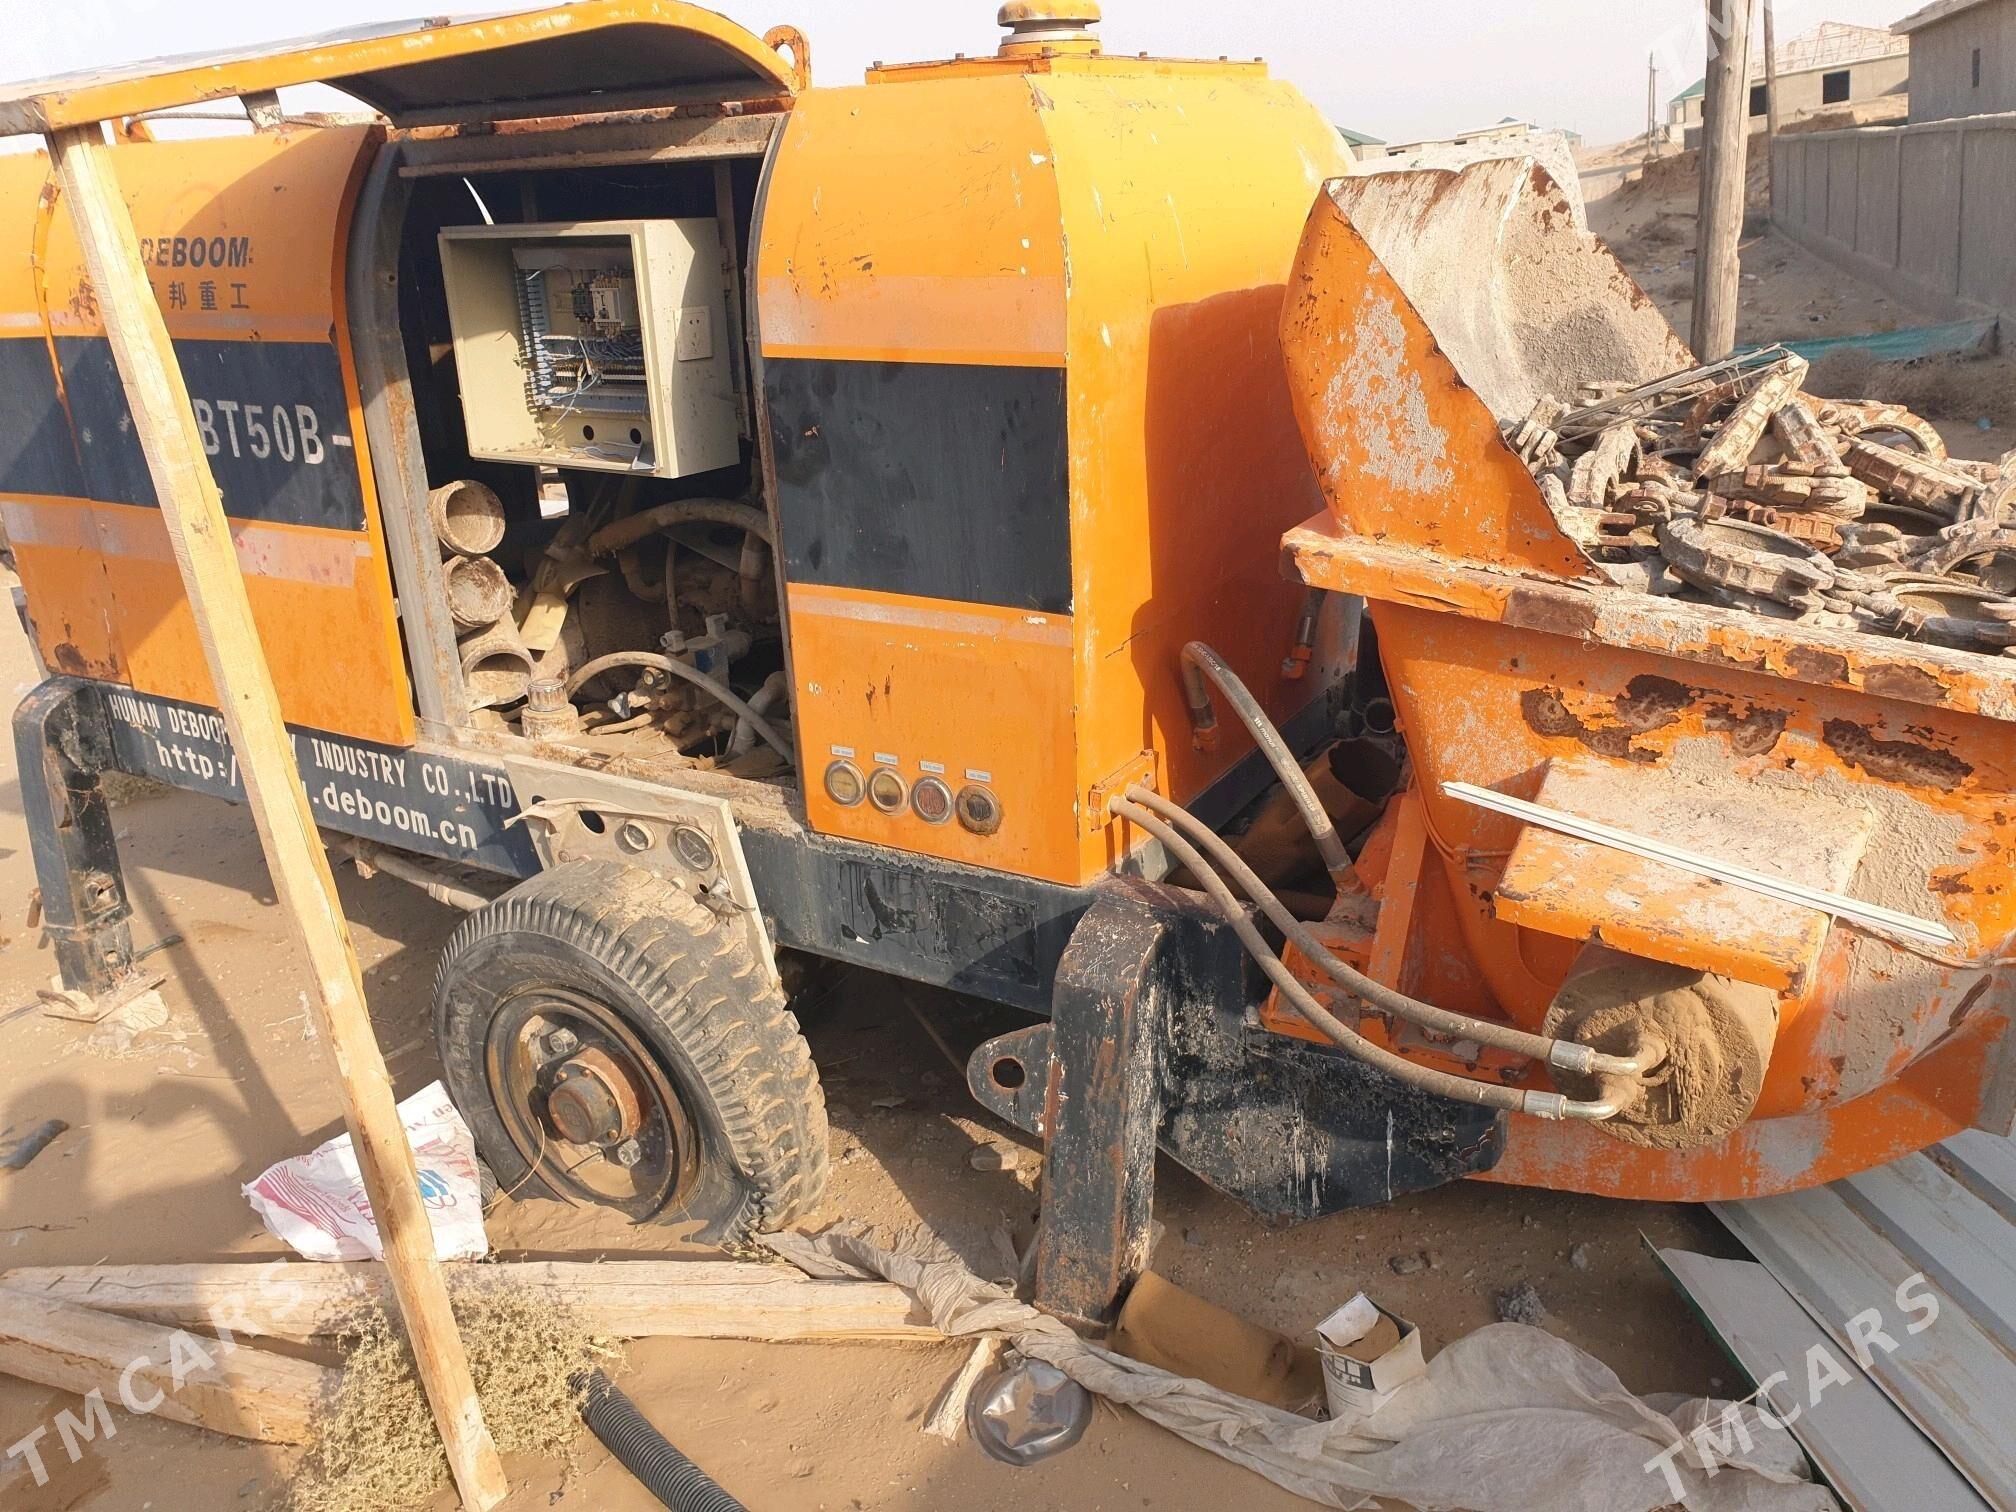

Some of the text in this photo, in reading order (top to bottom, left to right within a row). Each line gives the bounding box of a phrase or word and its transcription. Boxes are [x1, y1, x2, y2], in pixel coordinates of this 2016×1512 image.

[150, 280, 250, 311] 邦重工
[108, 694, 162, 729] HUNAN
[311, 738, 405, 788] INDUSTRY
[301, 780, 478, 850] .deboom.cn
